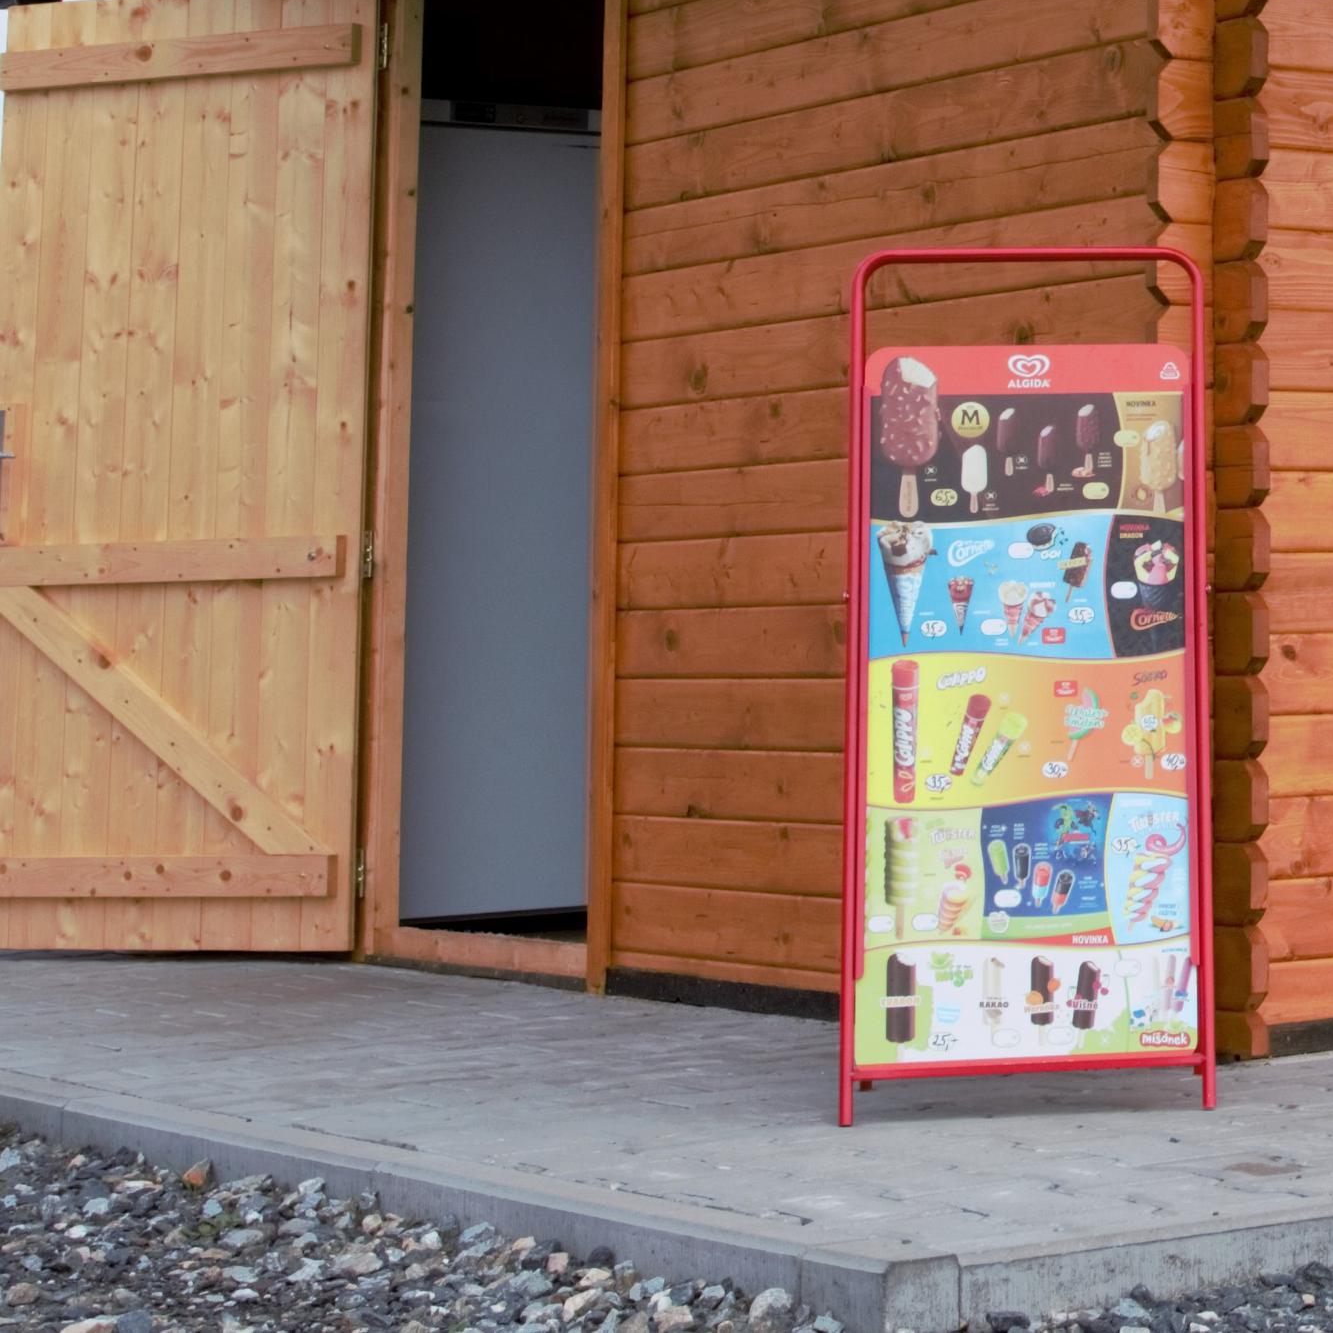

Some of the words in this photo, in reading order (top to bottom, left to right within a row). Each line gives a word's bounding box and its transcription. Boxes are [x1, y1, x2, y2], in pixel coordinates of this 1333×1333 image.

[1008, 378, 1051, 388] ALGIDA
[961, 410, 980, 426] M
[1072, 935, 1108, 944] NOVINKA
